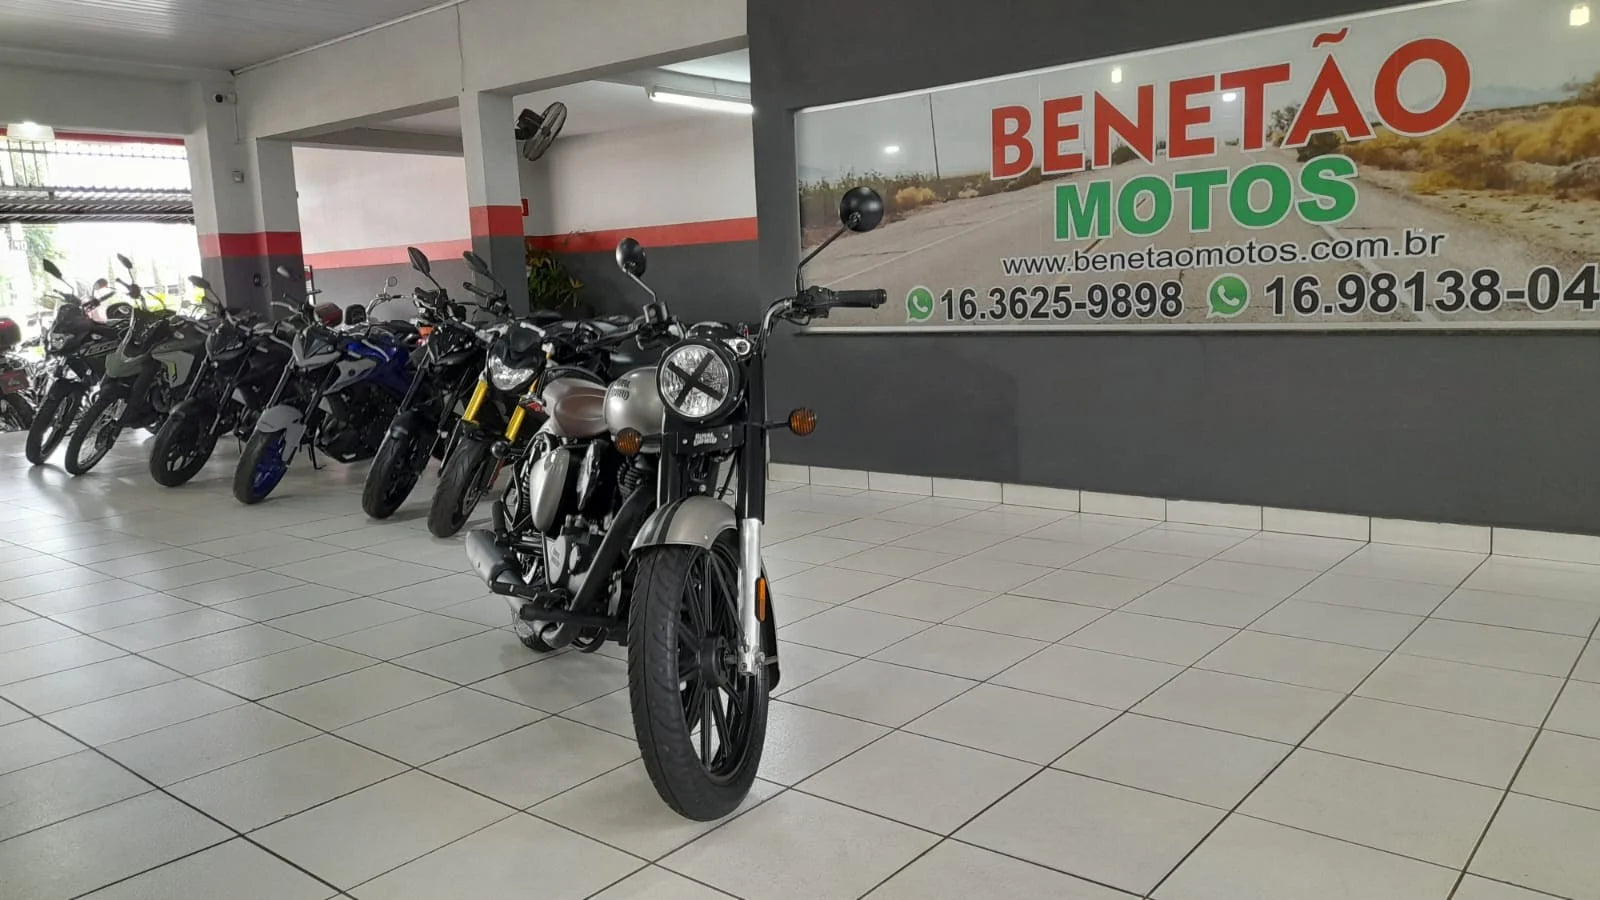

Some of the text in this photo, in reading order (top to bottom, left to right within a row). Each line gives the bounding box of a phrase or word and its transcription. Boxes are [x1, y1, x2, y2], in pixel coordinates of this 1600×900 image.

[990, 27, 1472, 179] BENETÃO
[1055, 157, 1358, 240] MOTOS
[1002, 230, 1445, 275] www.benetaomotos.com.br
[940, 264, 1600, 320] 16.3625-9898 16.98138-04
